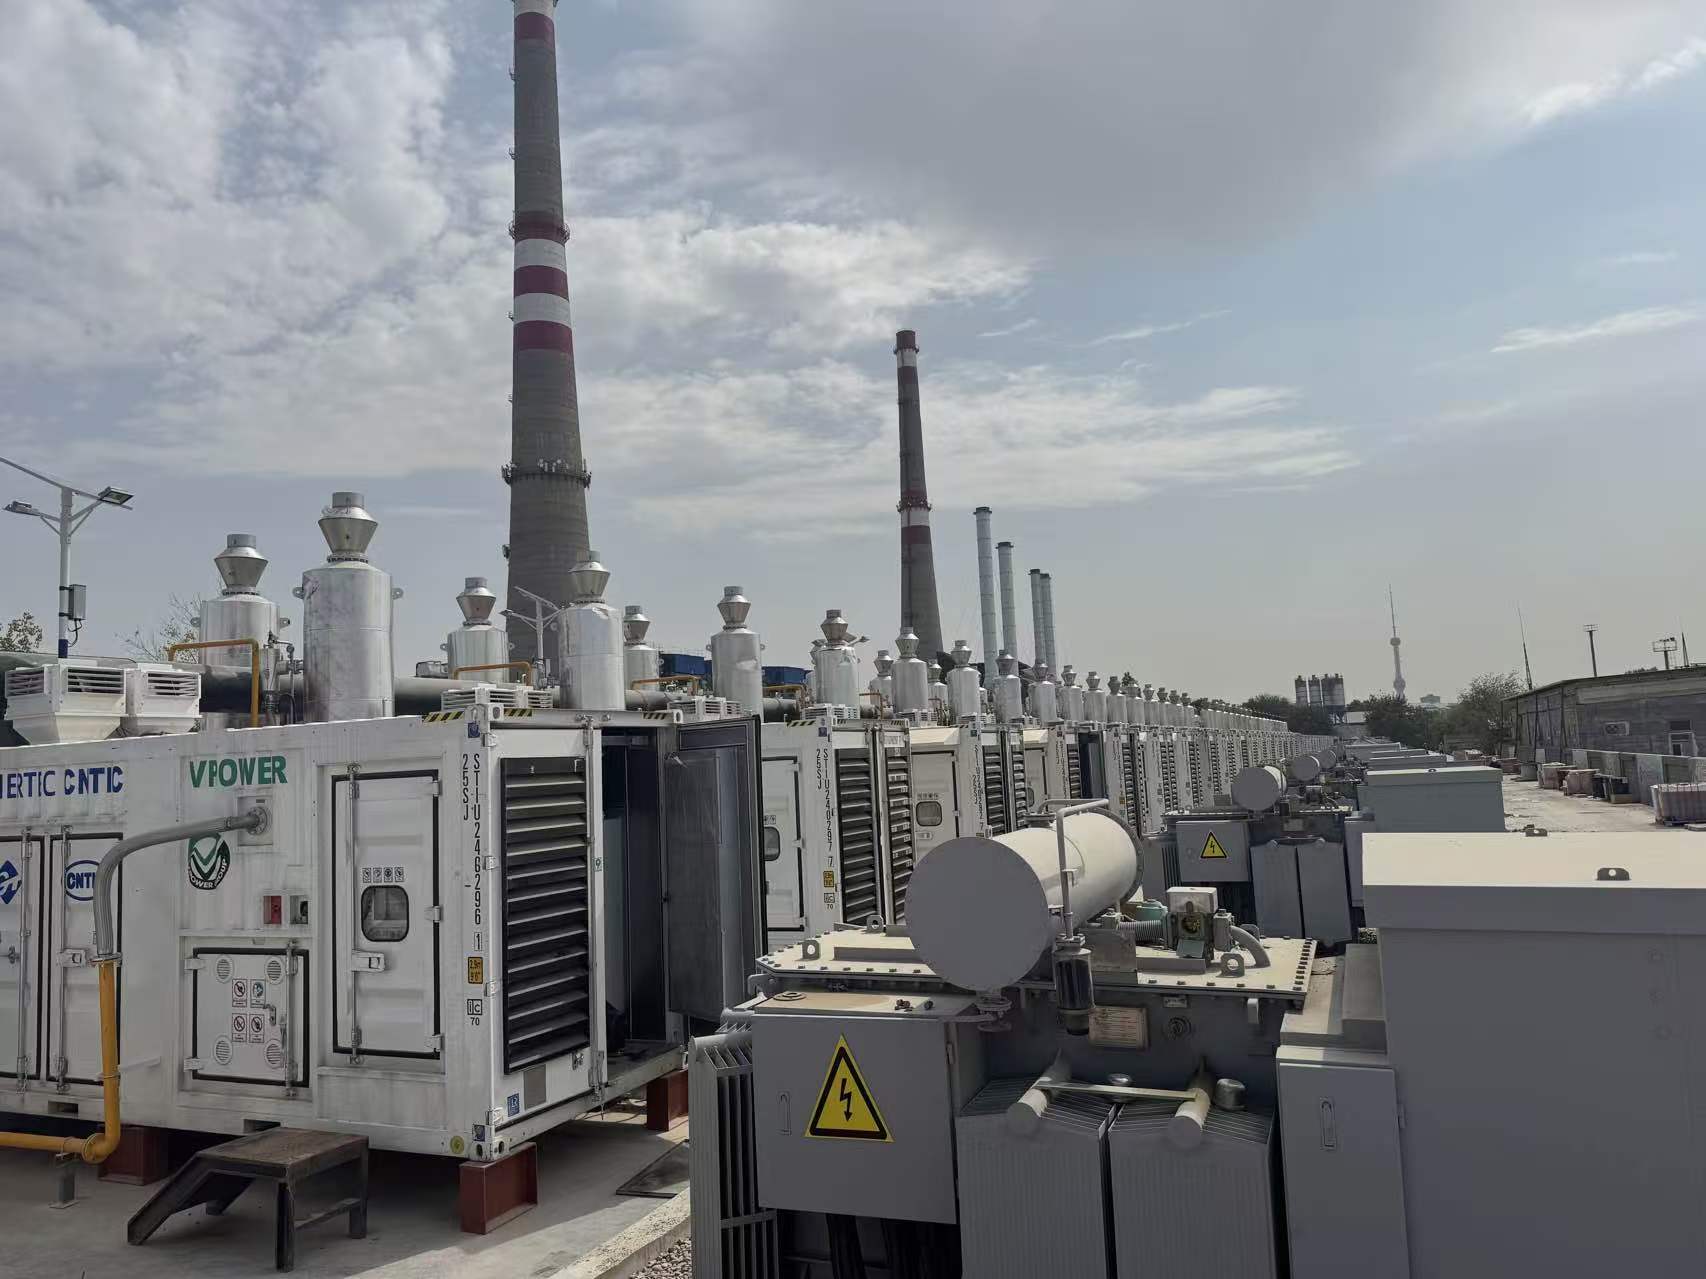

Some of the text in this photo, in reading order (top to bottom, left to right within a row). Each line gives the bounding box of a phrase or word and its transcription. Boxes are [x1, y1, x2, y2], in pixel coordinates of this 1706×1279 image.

[64, 766, 123, 795] CNTIC
[189, 755, 288, 788] VPOWER
[66, 872, 95, 889] CNTI
[470, 1017, 480, 1026] 70
